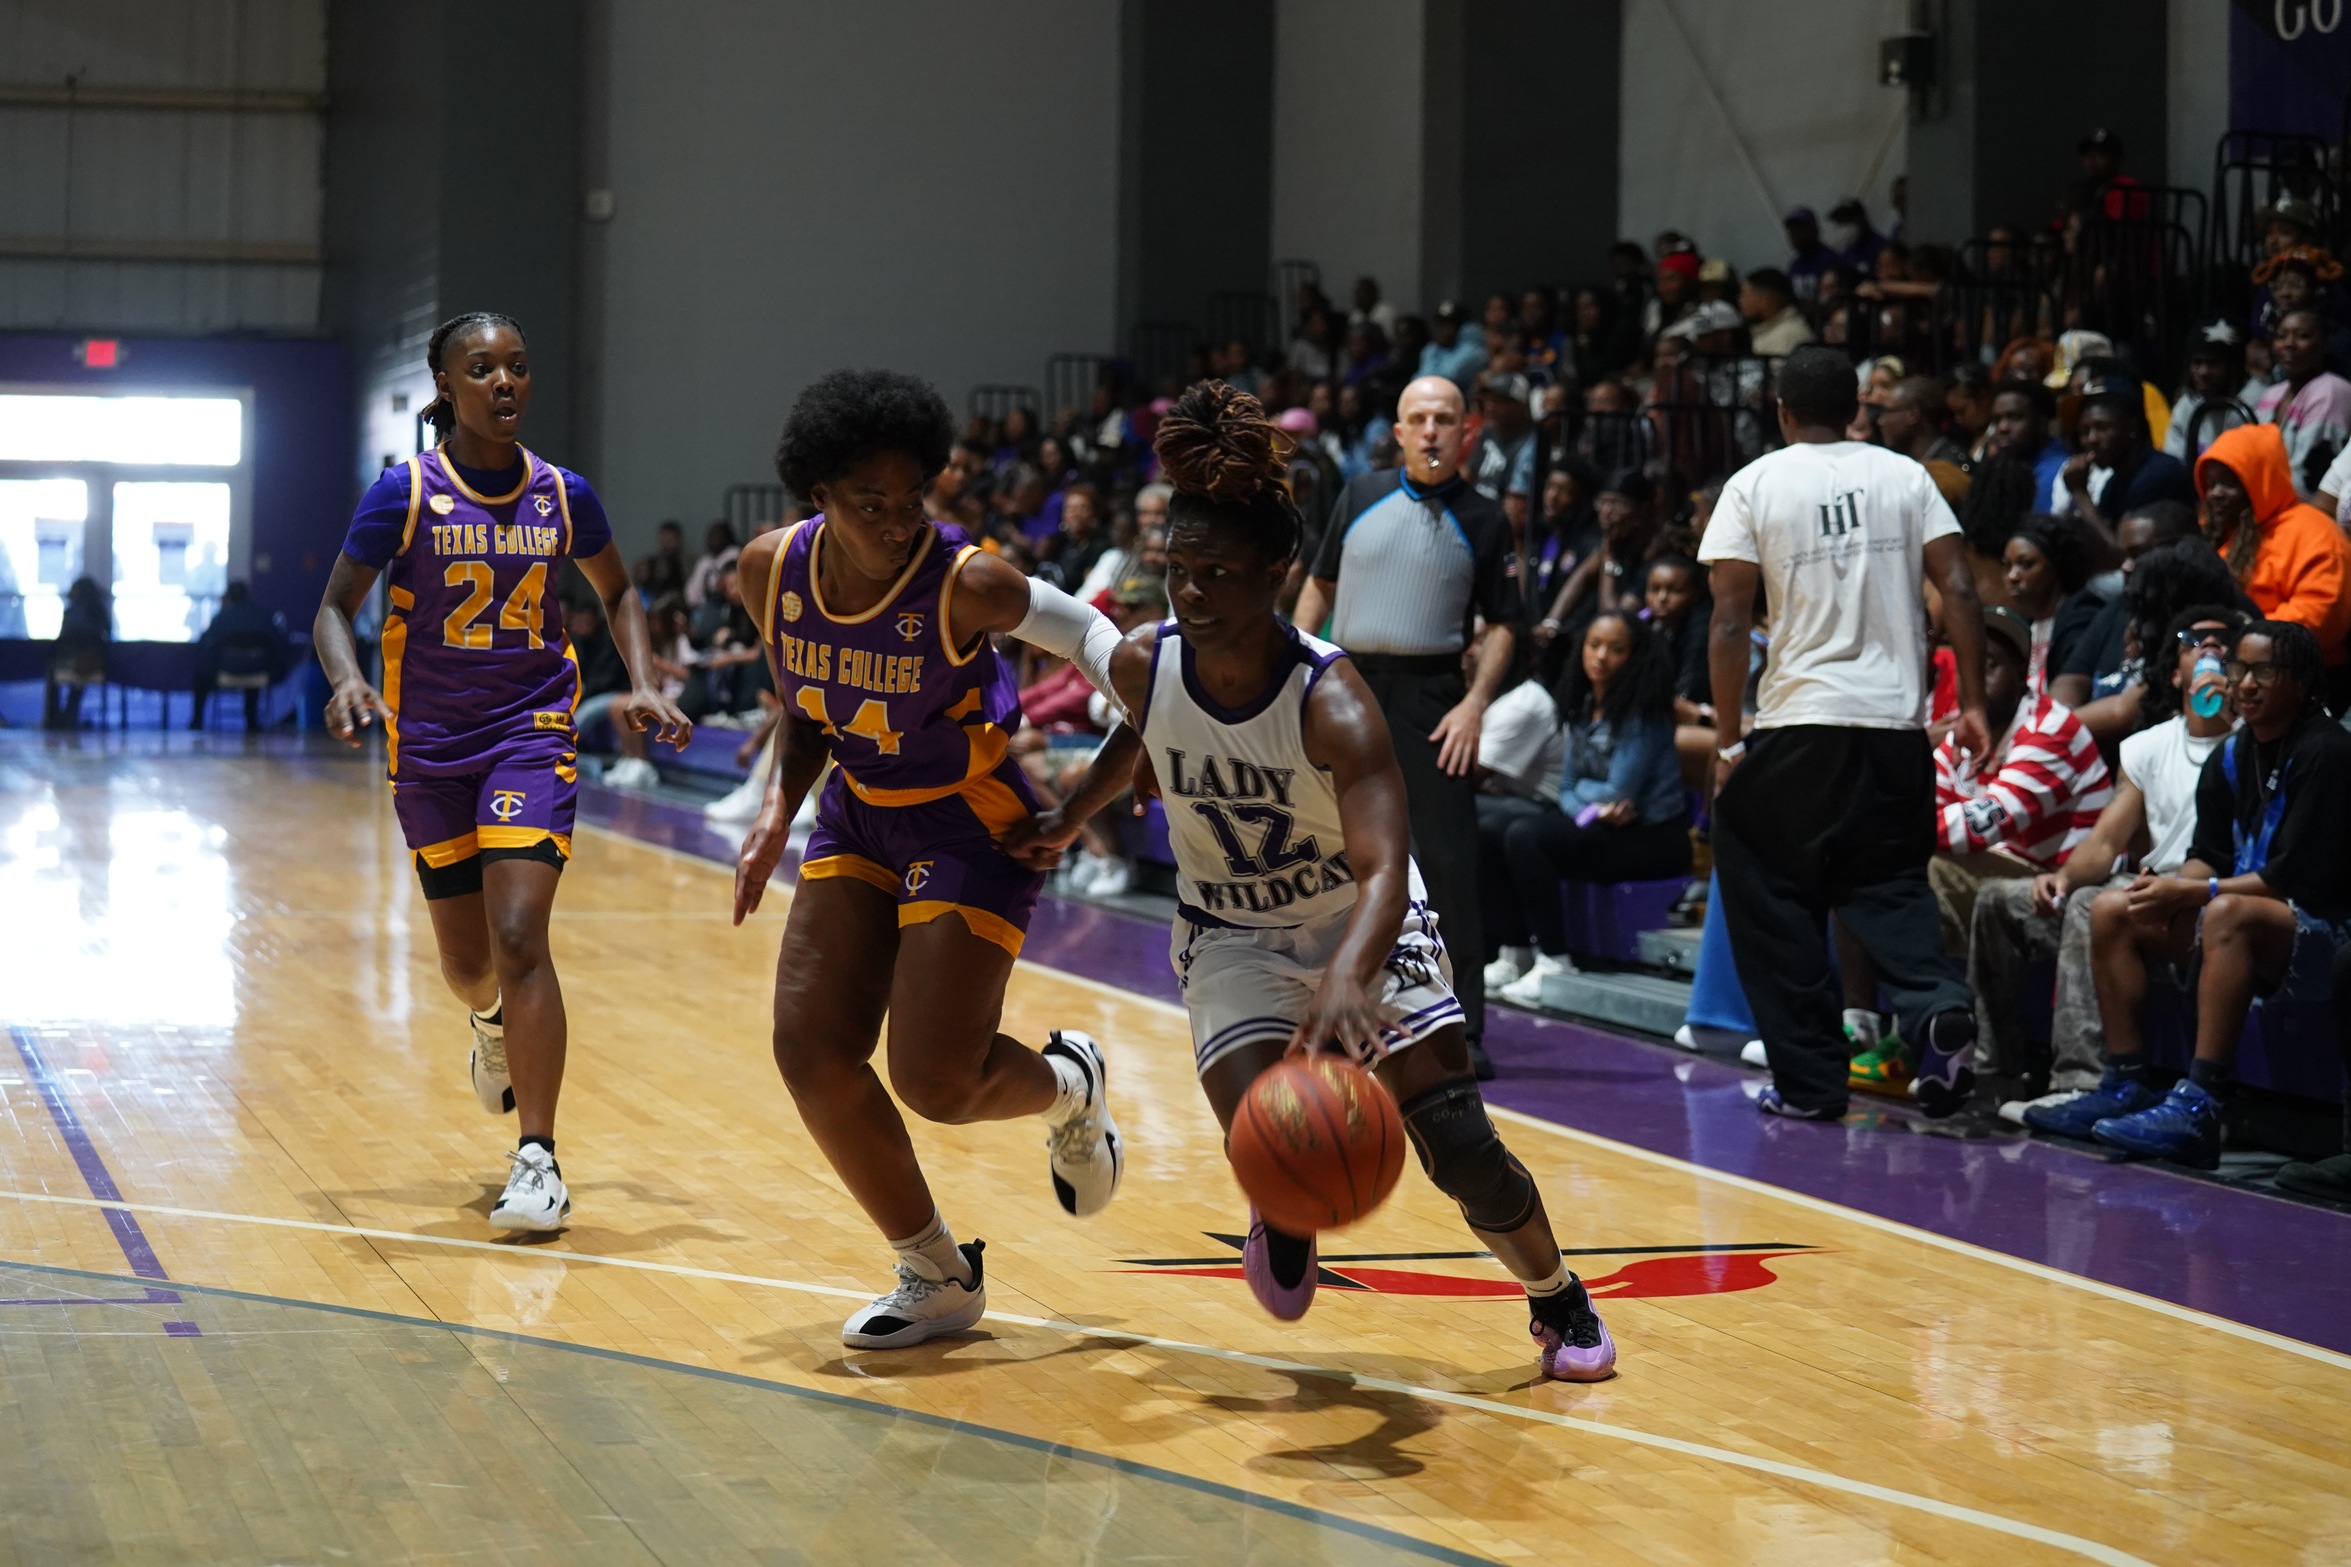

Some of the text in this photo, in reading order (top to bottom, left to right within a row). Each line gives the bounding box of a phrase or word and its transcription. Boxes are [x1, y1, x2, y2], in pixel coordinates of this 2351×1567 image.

[432, 524, 558, 556] TEXAS COLLEGE
[442, 561, 547, 650] 24
[780, 631, 925, 694] TEXAS COLLEGE
[796, 685, 905, 756] 14
[1166, 747, 1295, 808] LADY
[1192, 800, 1320, 878] 12
